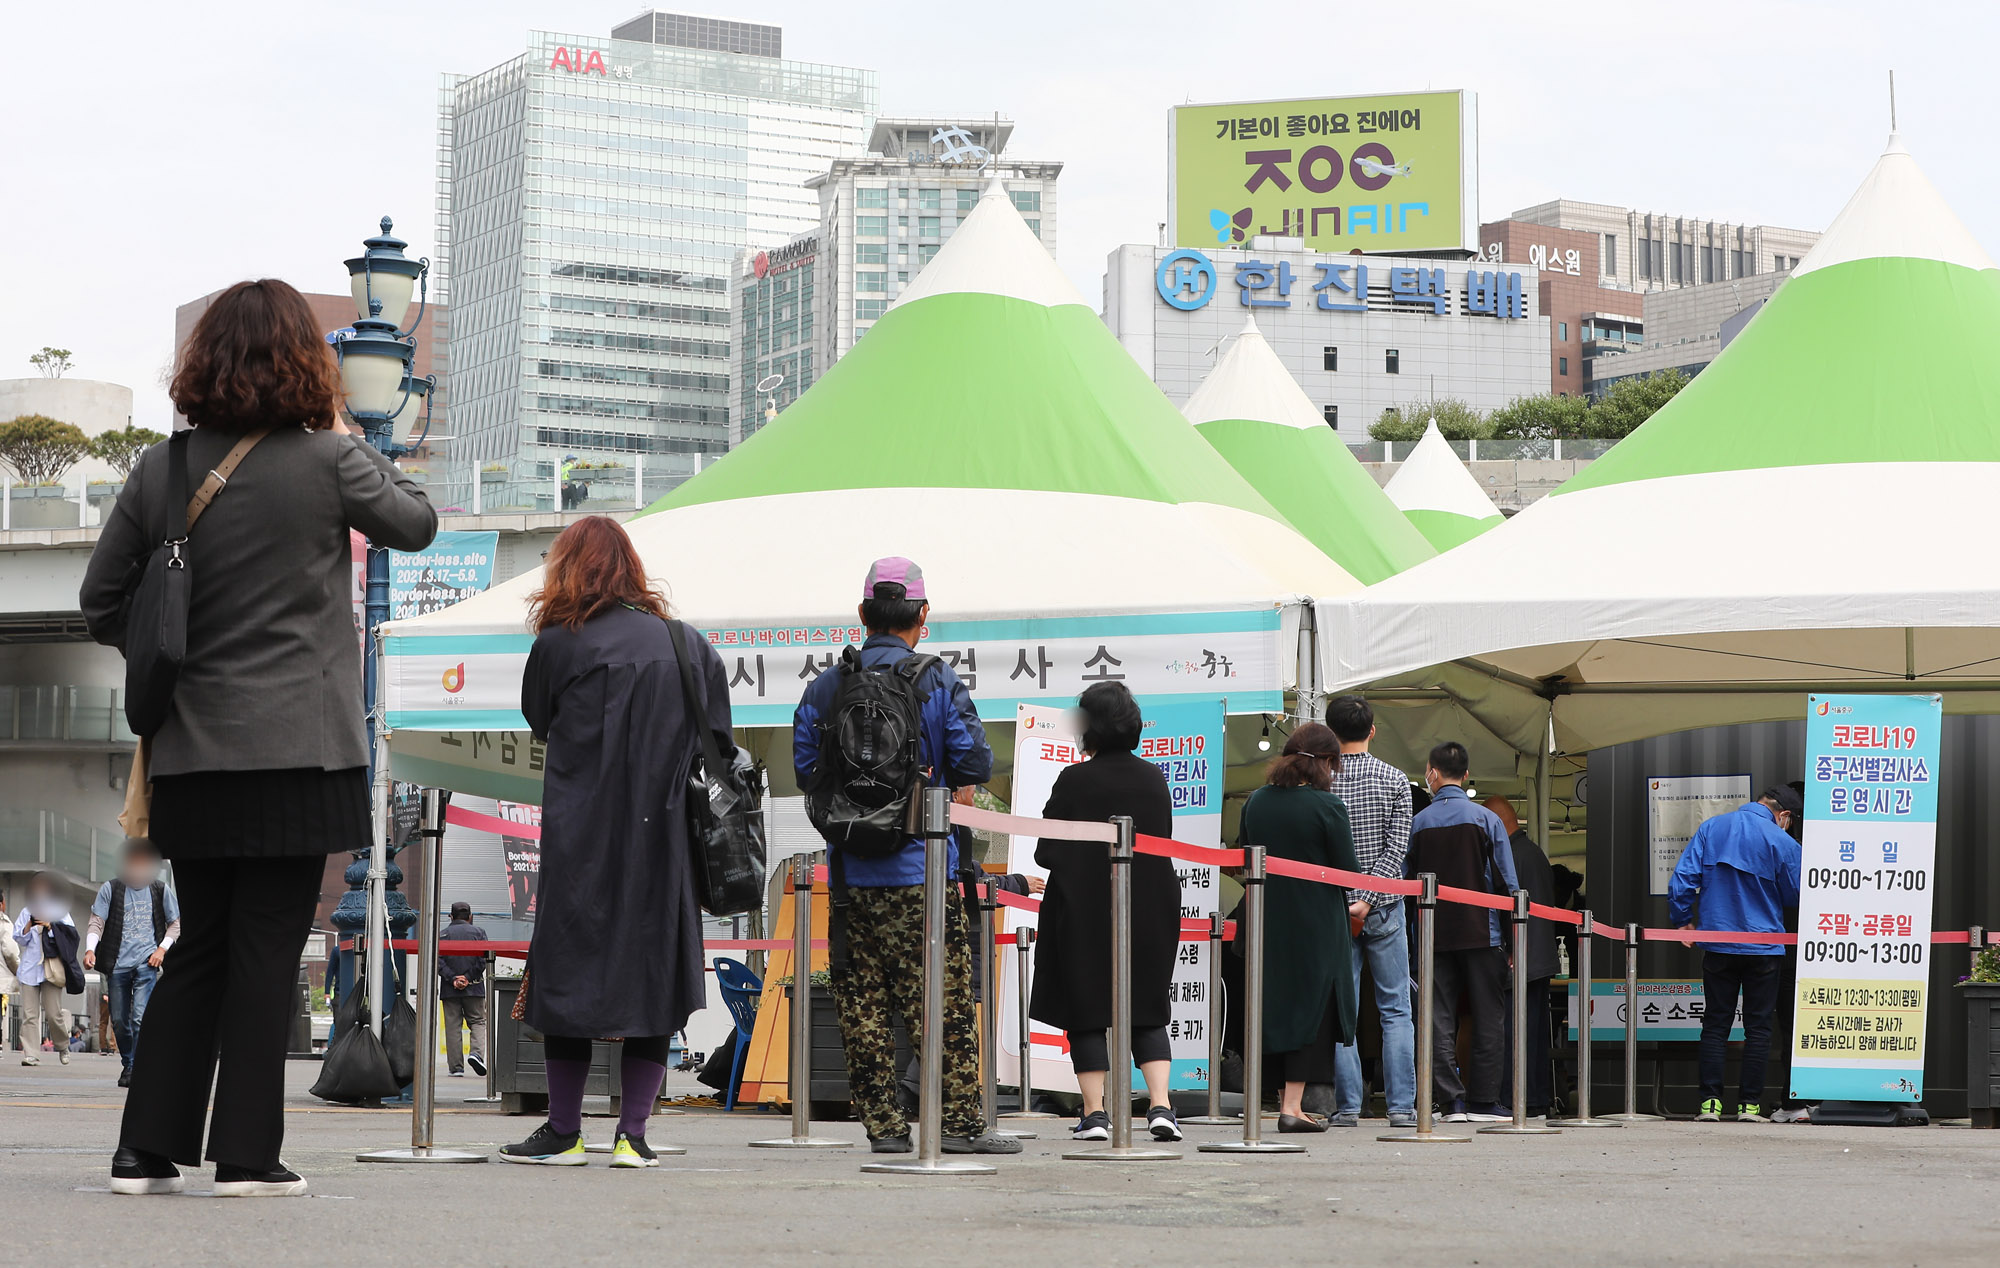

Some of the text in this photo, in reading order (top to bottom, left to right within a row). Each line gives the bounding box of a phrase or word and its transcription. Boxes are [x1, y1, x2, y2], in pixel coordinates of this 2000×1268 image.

[549, 46, 634, 79] AIA 생명
[1216, 108, 1421, 141] 기본이 좋아요 진에어
[1529, 244, 1581, 276] 에스원
[1235, 260, 1523, 319] 한진택배
[1200, 648, 1233, 679] 중구
[1140, 735, 1205, 758] 코로나19
[1832, 725, 1917, 749] 코로나19
[1816, 756, 1929, 782] 중구선별검사소
[1172, 785, 1207, 809] 안내
[1831, 787, 1912, 815] 운영시간
[1191, 867, 1210, 889] 작성
[1807, 867, 1926, 891] 09:00~17:00
[1179, 944, 1199, 965] 수령
[1804, 940, 1922, 964] 09:00~13:00
[1182, 983, 1205, 1002] 채취)
[1844, 988, 1921, 1008] 12:30~13:30(평일)
[1641, 1002, 1662, 1023] 손
[1816, 1015, 1903, 1032] 소독시간에는 검사가
[1170, 1019, 1204, 1041] 후 귀가
[1800, 1034, 1917, 1051] 불가능하오니 양해 바랍니다
